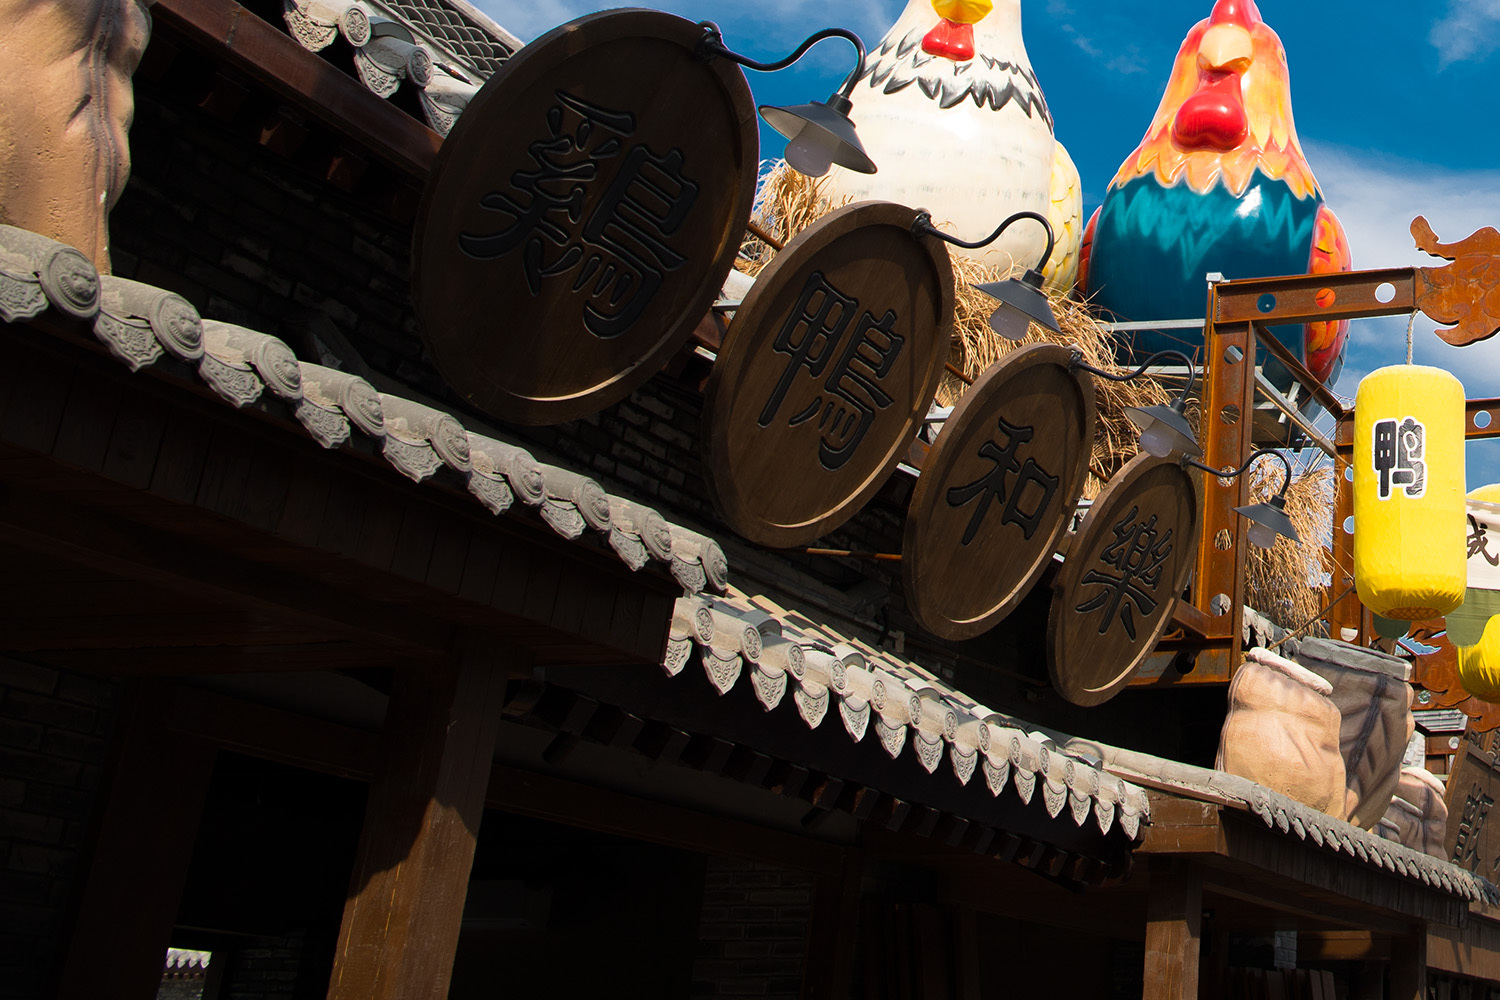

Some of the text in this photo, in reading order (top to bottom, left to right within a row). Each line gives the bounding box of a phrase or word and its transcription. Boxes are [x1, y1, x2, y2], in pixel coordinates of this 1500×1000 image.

[756, 270, 906, 473] 鴨
[947, 415, 1060, 546] 和
[1373, 418, 1426, 499] 鸭
[1075, 504, 1174, 640] 樂
